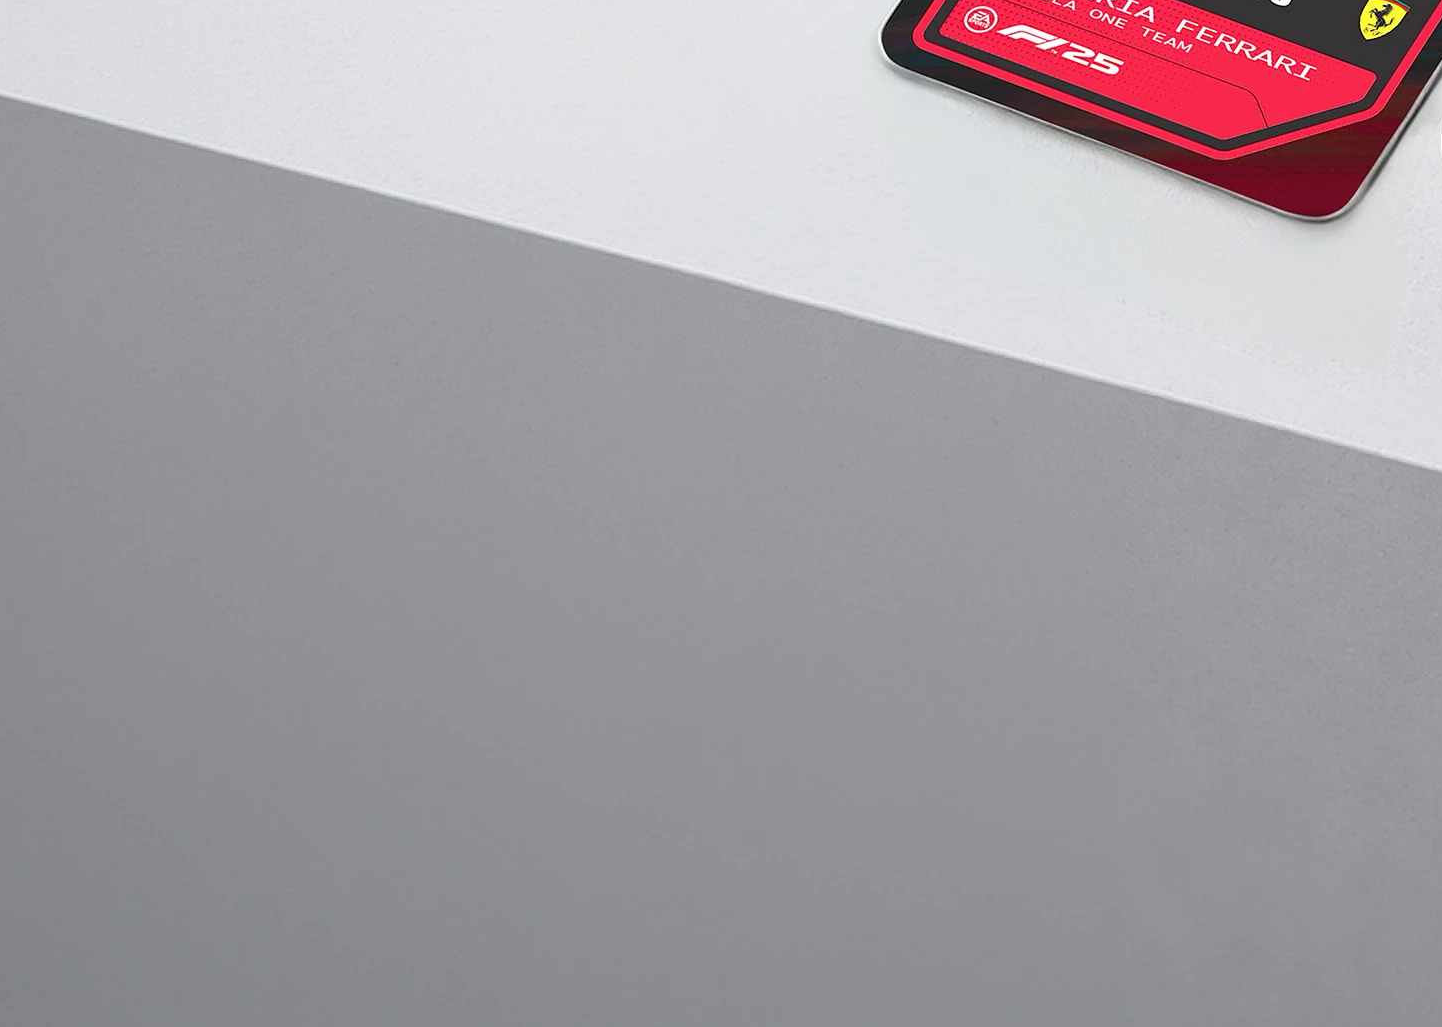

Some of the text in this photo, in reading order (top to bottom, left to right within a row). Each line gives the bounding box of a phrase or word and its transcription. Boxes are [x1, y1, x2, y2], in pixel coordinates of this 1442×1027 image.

[1089, 9, 1127, 29] ONE
[1141, 27, 1193, 54] TEAM
[1175, 18, 1318, 81] FERRARI
